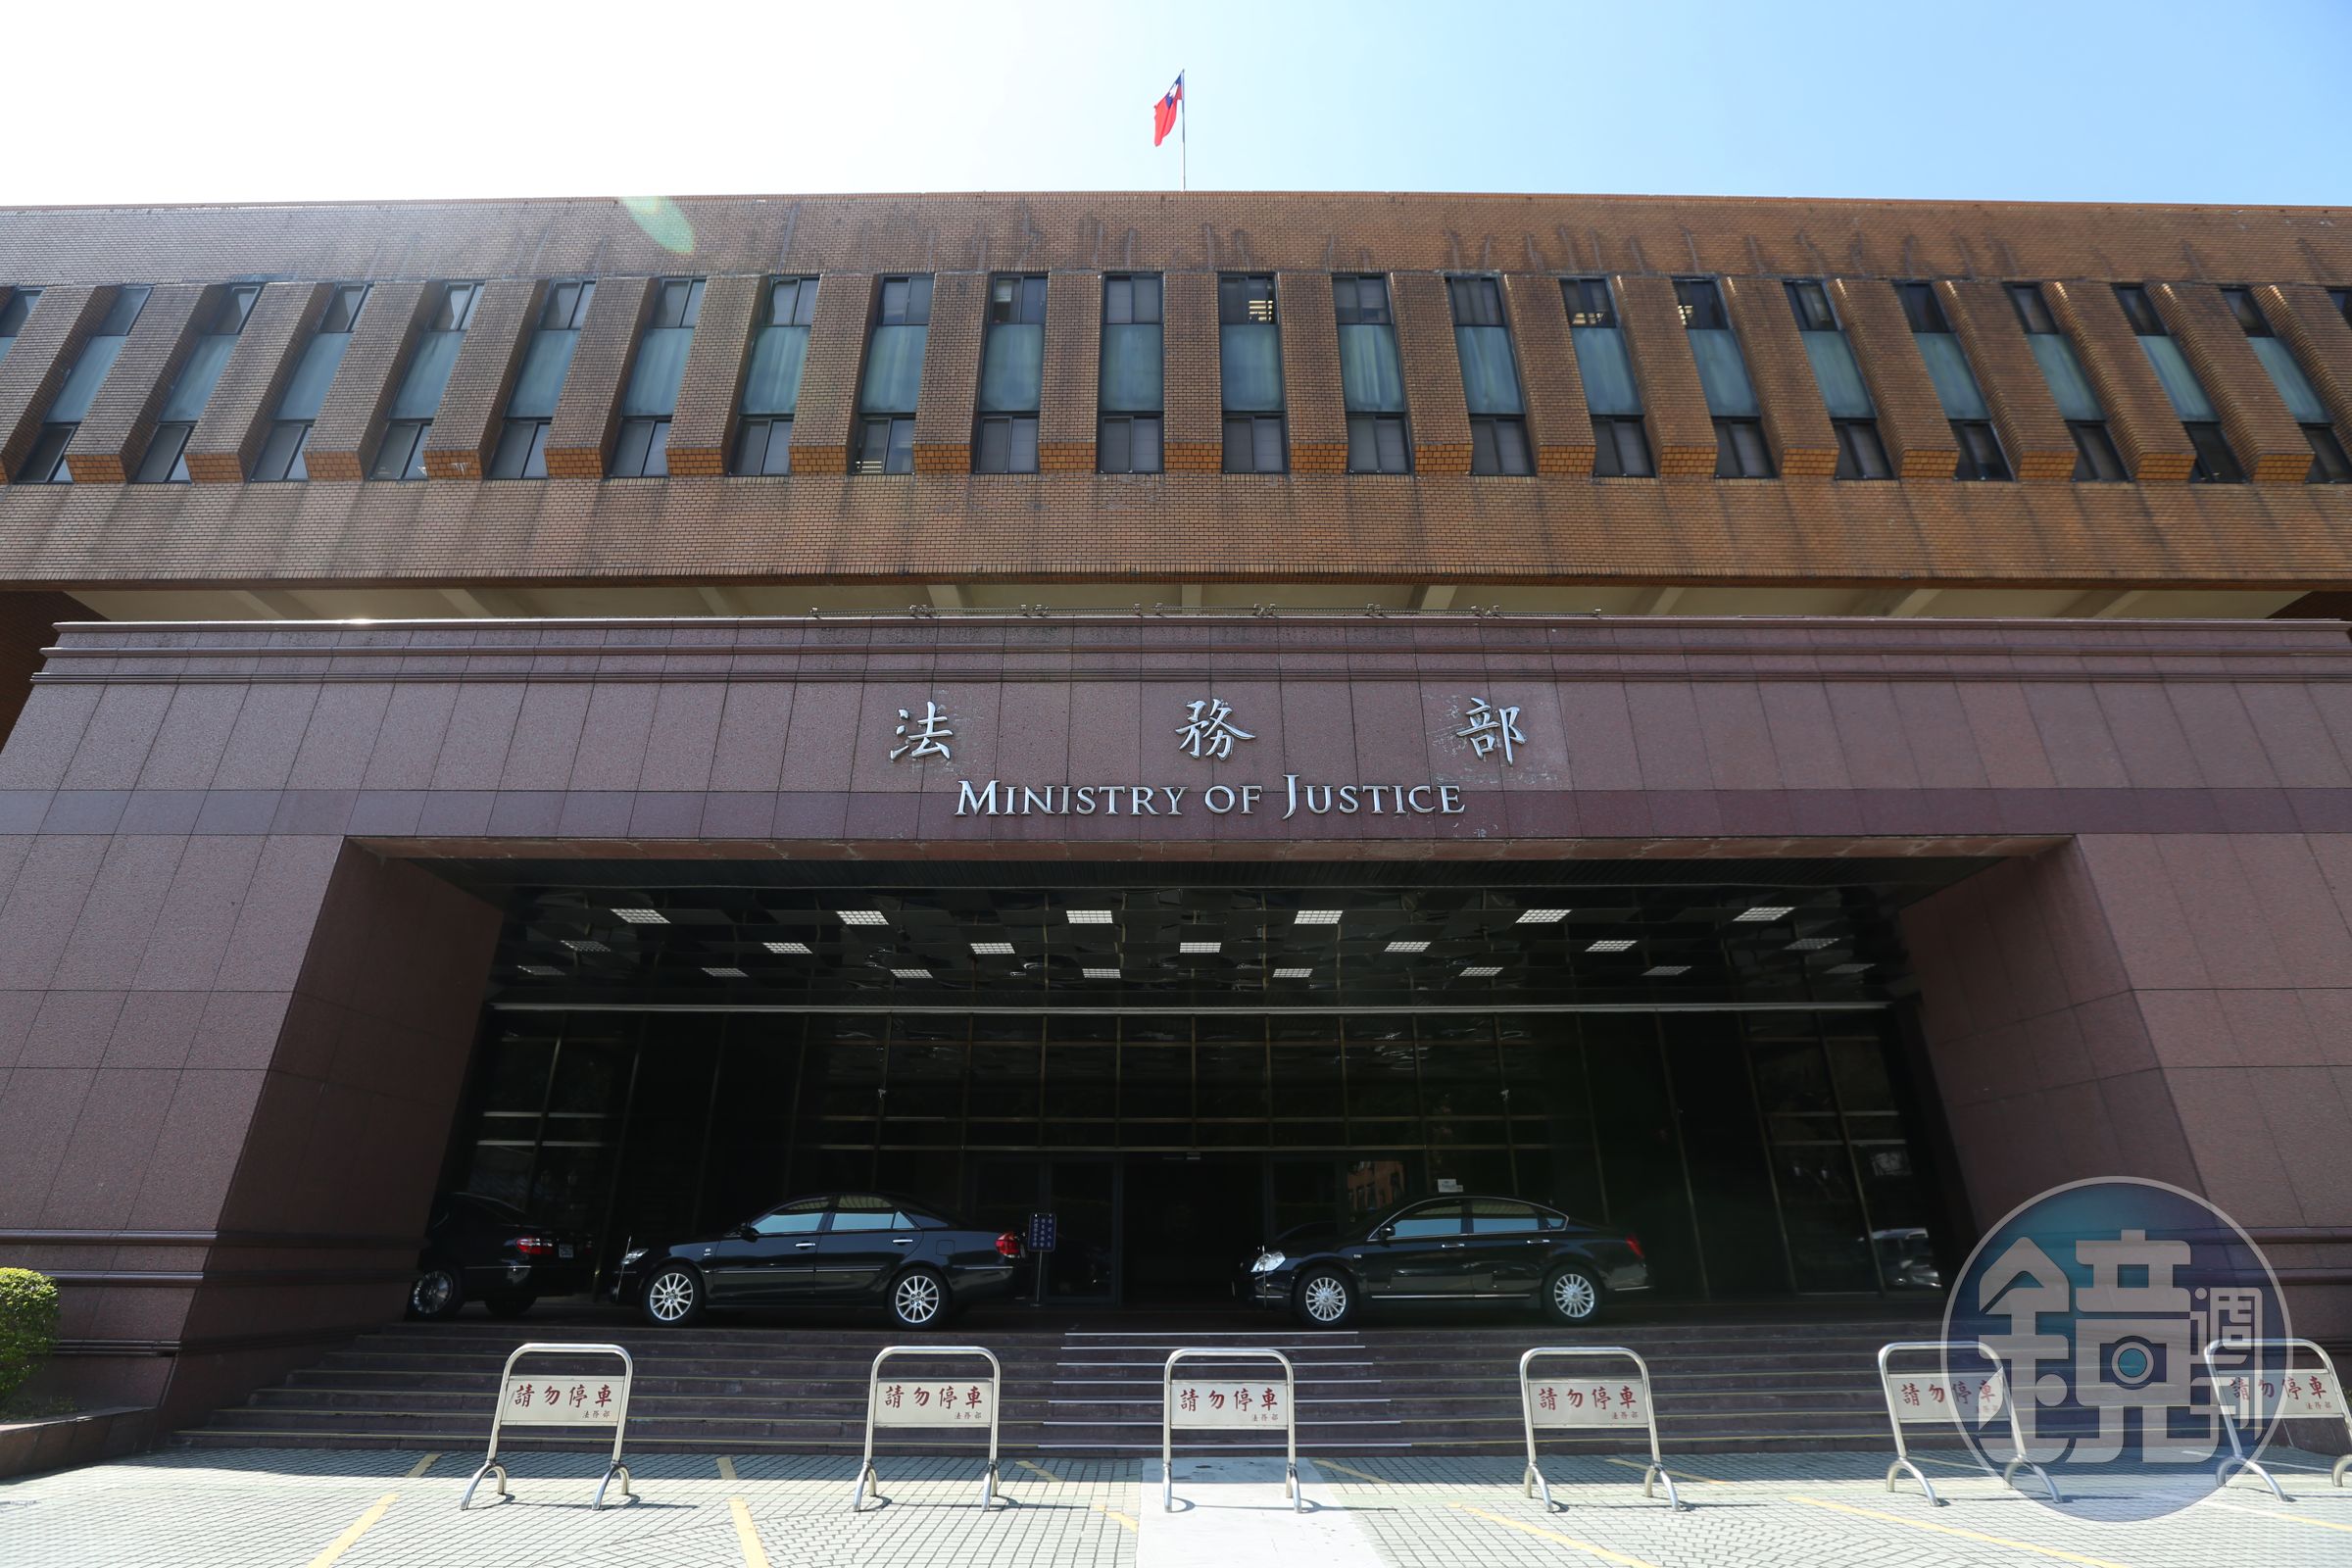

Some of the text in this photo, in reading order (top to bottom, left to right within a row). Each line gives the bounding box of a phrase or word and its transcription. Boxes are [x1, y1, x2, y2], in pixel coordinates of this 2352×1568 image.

[890, 697, 1527, 766] 法務部
[955, 774, 1466, 820] MINISTRY OF JUSTICE
[514, 1383, 612, 1408] 請勿停車
[885, 1385, 982, 1409] 請勿停車
[1180, 1388, 1278, 1411] 請勿停車
[1539, 1385, 1637, 1410] 請勿停車
[1901, 1380, 1995, 1406] 請勿停車
[2230, 1375, 2327, 1400] 請勿停車
